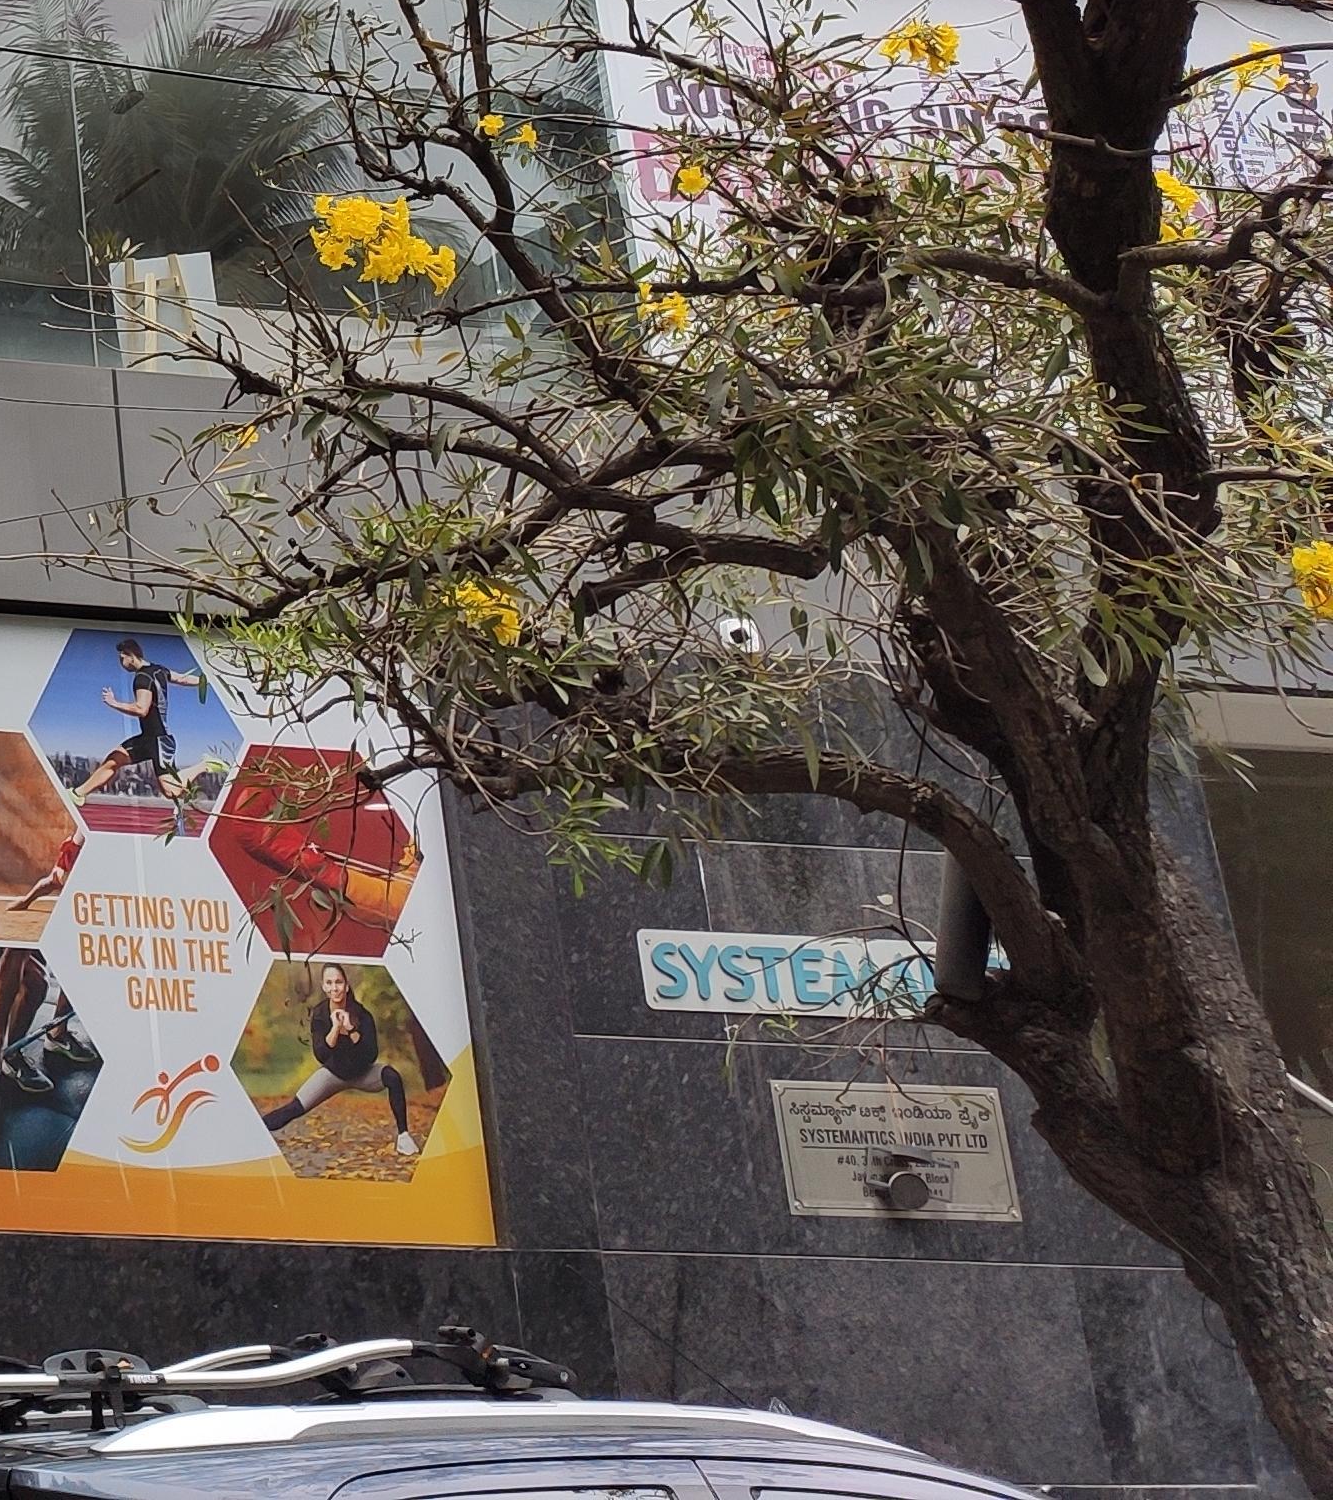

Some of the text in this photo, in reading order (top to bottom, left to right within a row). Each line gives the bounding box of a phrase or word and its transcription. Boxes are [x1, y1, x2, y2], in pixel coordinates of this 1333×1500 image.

[73, 891, 231, 933] GETTING YOU
[79, 932, 233, 975] BACK IN THE
[126, 975, 199, 1012] GAME
[799, 1128, 989, 1149] SYSTEMANTICS INDIA PVT LTD
